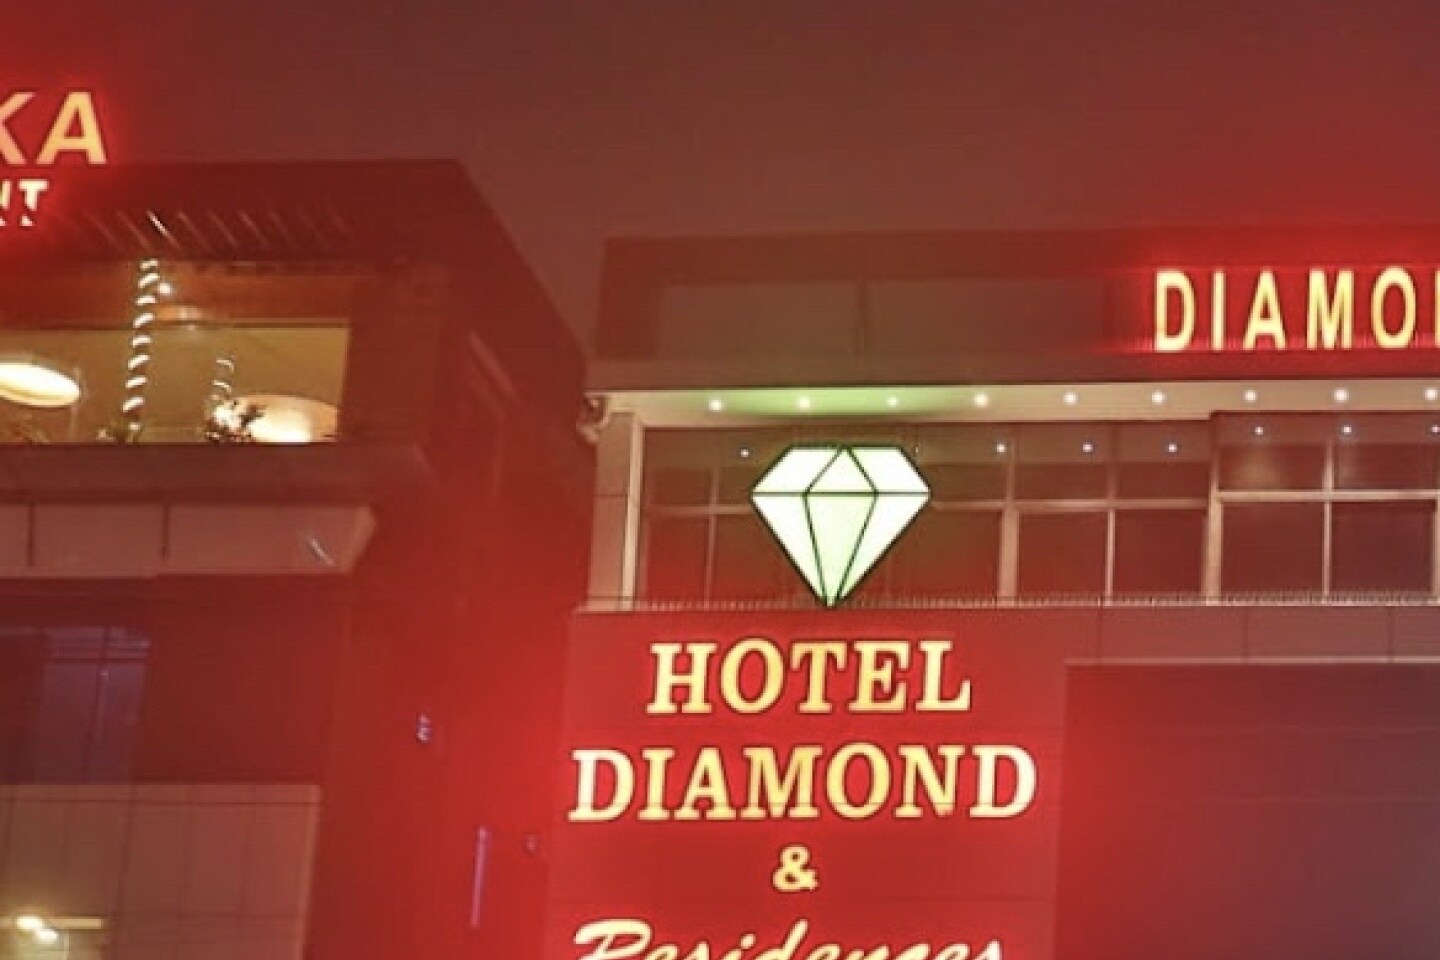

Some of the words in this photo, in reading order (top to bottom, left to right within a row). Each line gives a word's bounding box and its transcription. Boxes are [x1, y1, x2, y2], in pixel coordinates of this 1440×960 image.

[646, 637, 973, 715] HOTEL
[568, 742, 1039, 821] DIAMOND
[772, 845, 819, 893] &
